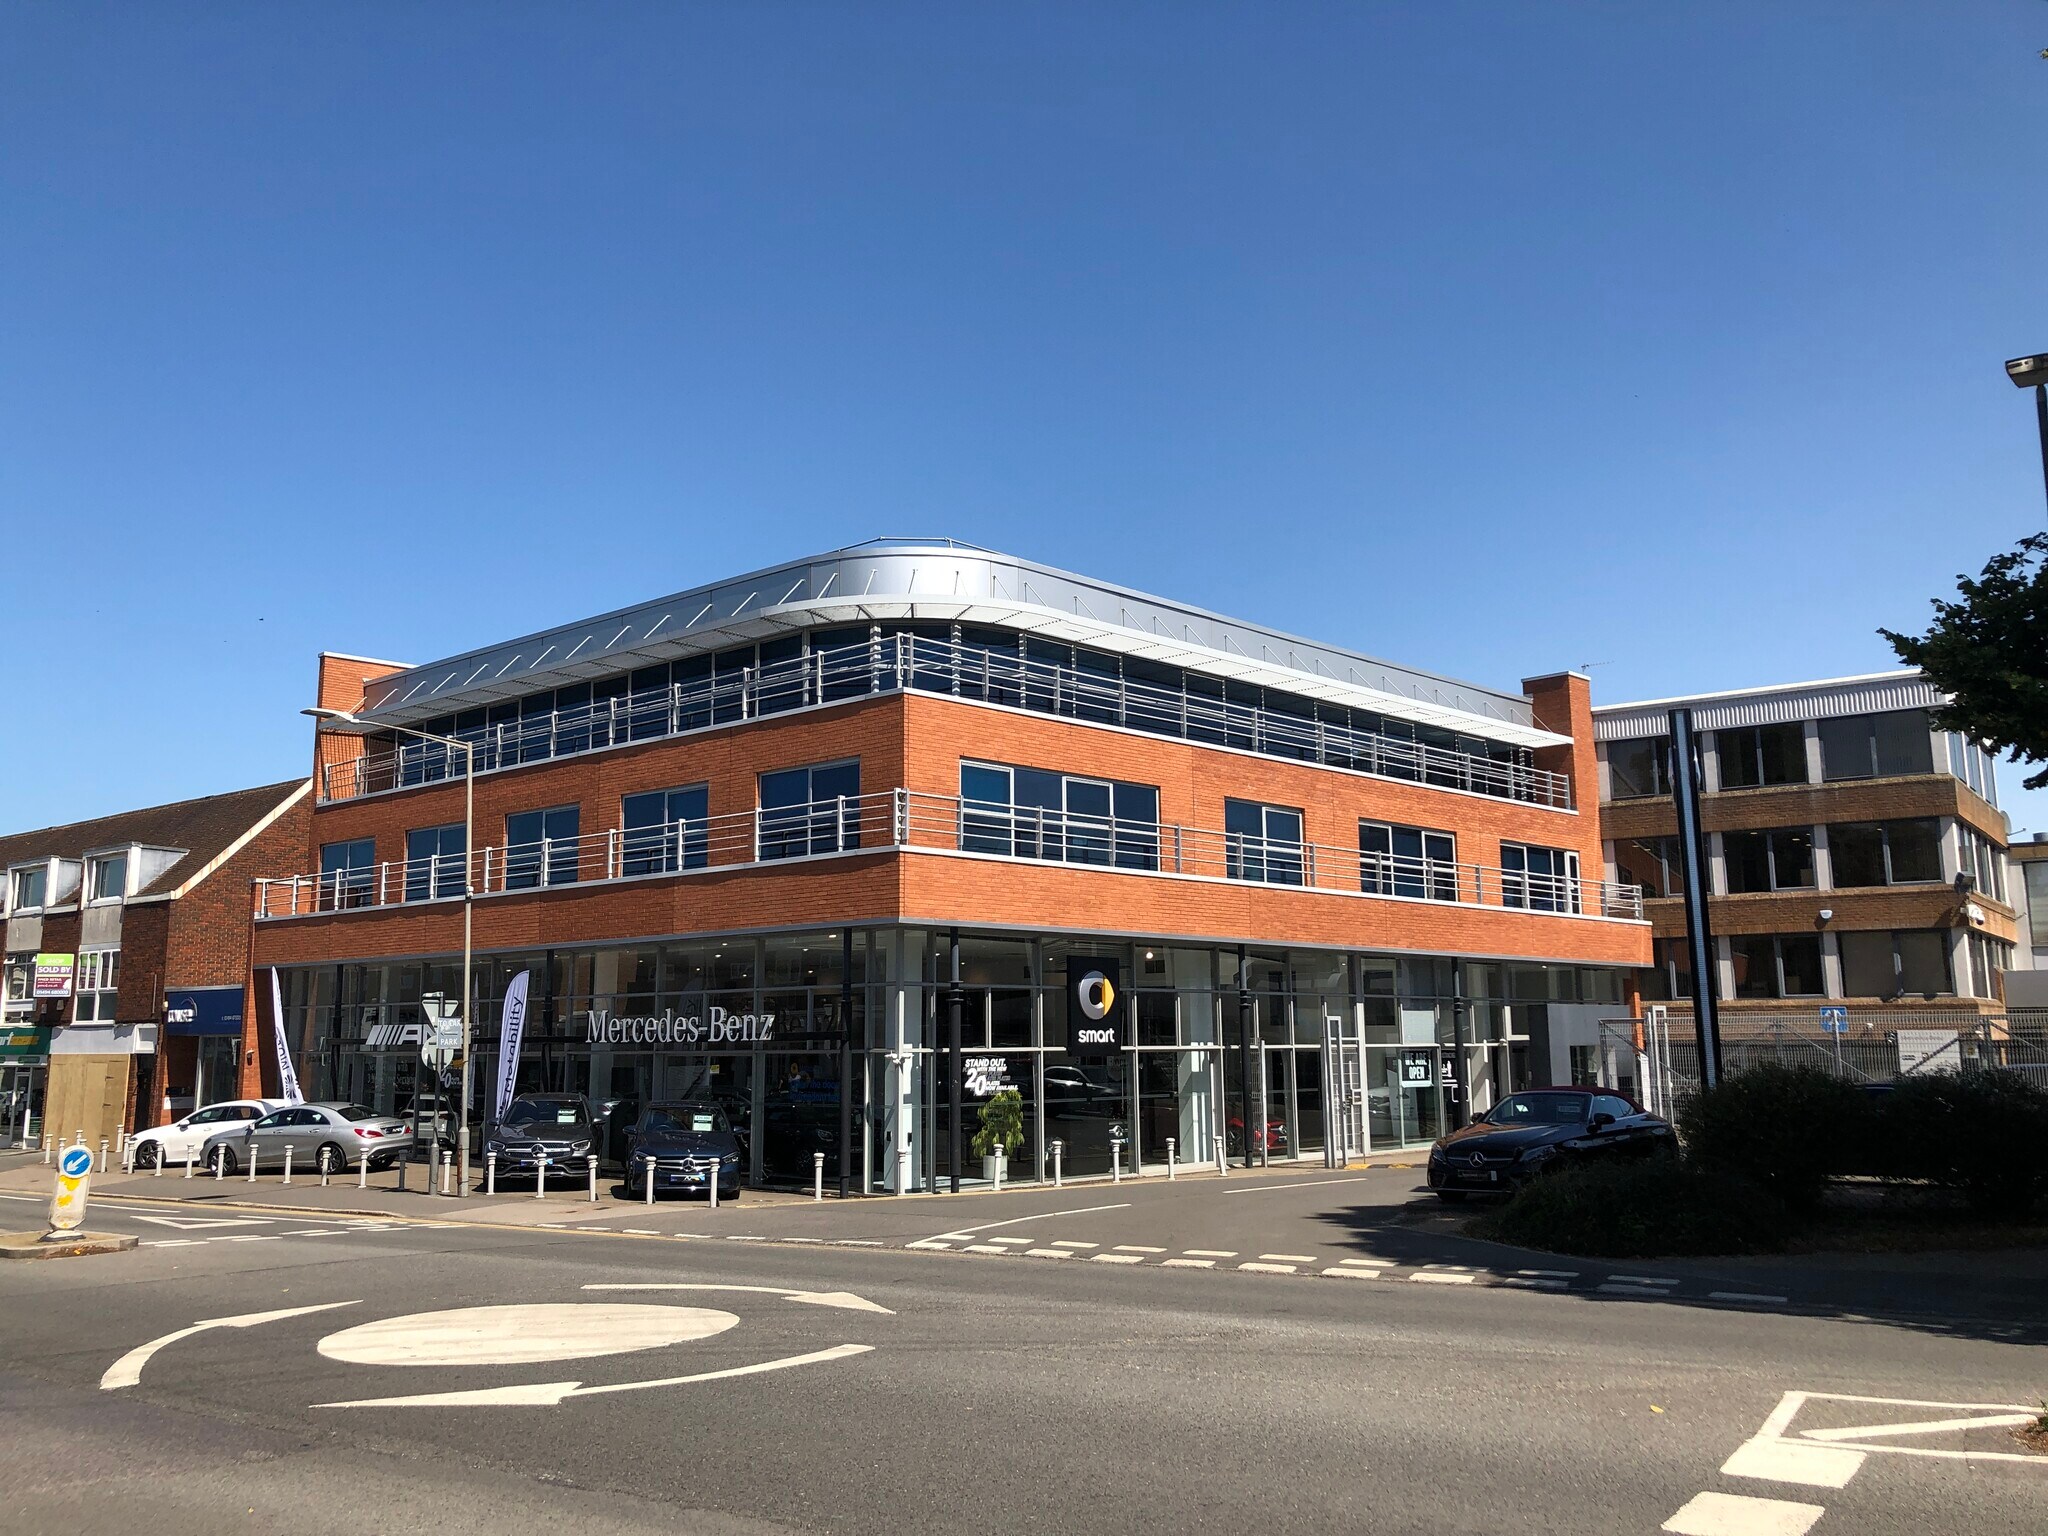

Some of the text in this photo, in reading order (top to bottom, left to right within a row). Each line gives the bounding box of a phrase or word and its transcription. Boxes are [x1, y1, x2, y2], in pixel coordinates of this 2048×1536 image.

[37, 966, 72, 974] SOLD BY
[585, 1006, 775, 1043] Mercedes-Benz
[440, 1038, 458, 1046] PARK
[1078, 1028, 1115, 1043] smart
[504, 996, 523, 1093] Motability
[964, 1058, 1007, 1067] STAND OUT.
[1405, 1053, 1427, 1065] WE ARE
[1409, 1066, 1425, 1079] OPEN
[965, 1067, 986, 1096] 20
